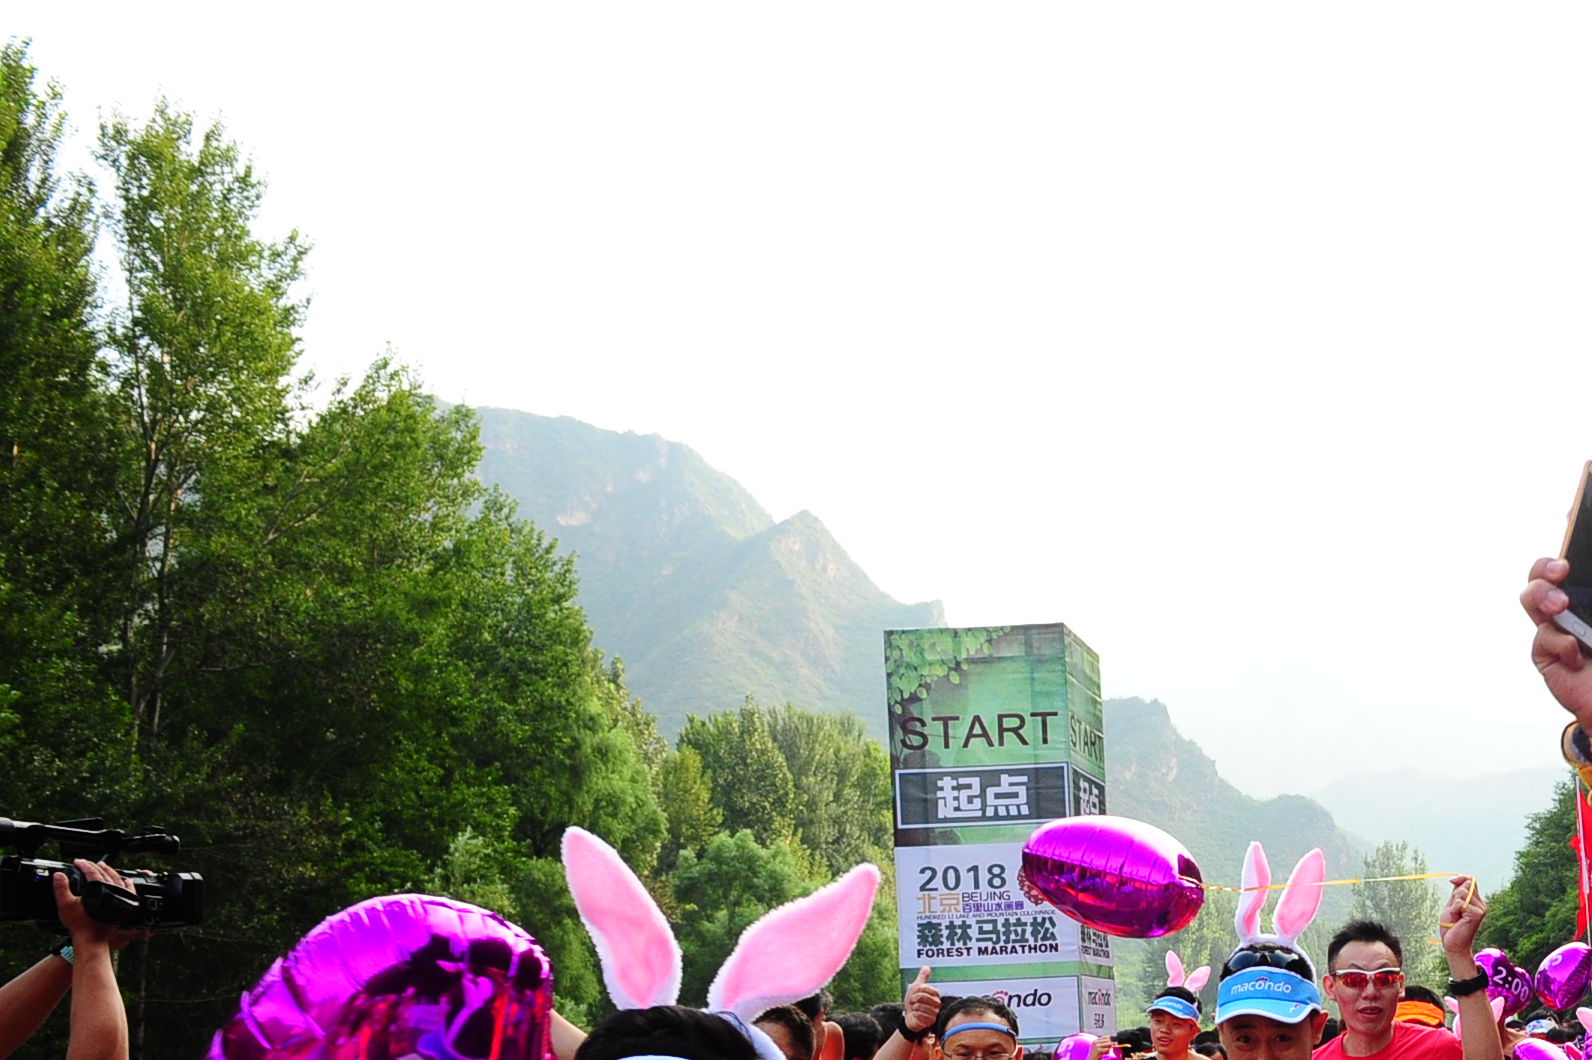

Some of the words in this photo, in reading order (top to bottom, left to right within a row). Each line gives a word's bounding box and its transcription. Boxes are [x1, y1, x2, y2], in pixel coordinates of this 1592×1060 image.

[900, 712, 1058, 751] START
[937, 774, 1029, 819] 起点
[918, 864, 1007, 892] 2018
[917, 893, 961, 914] 北京
[962, 891, 1010, 903] BEIJING
[917, 917, 1058, 948] 森林马拉松
[917, 947, 973, 958] FOREST
[977, 943, 1059, 956] MARATHON
[1230, 977, 1292, 995] macondo
[1493, 966, 1529, 1002] 2:00
